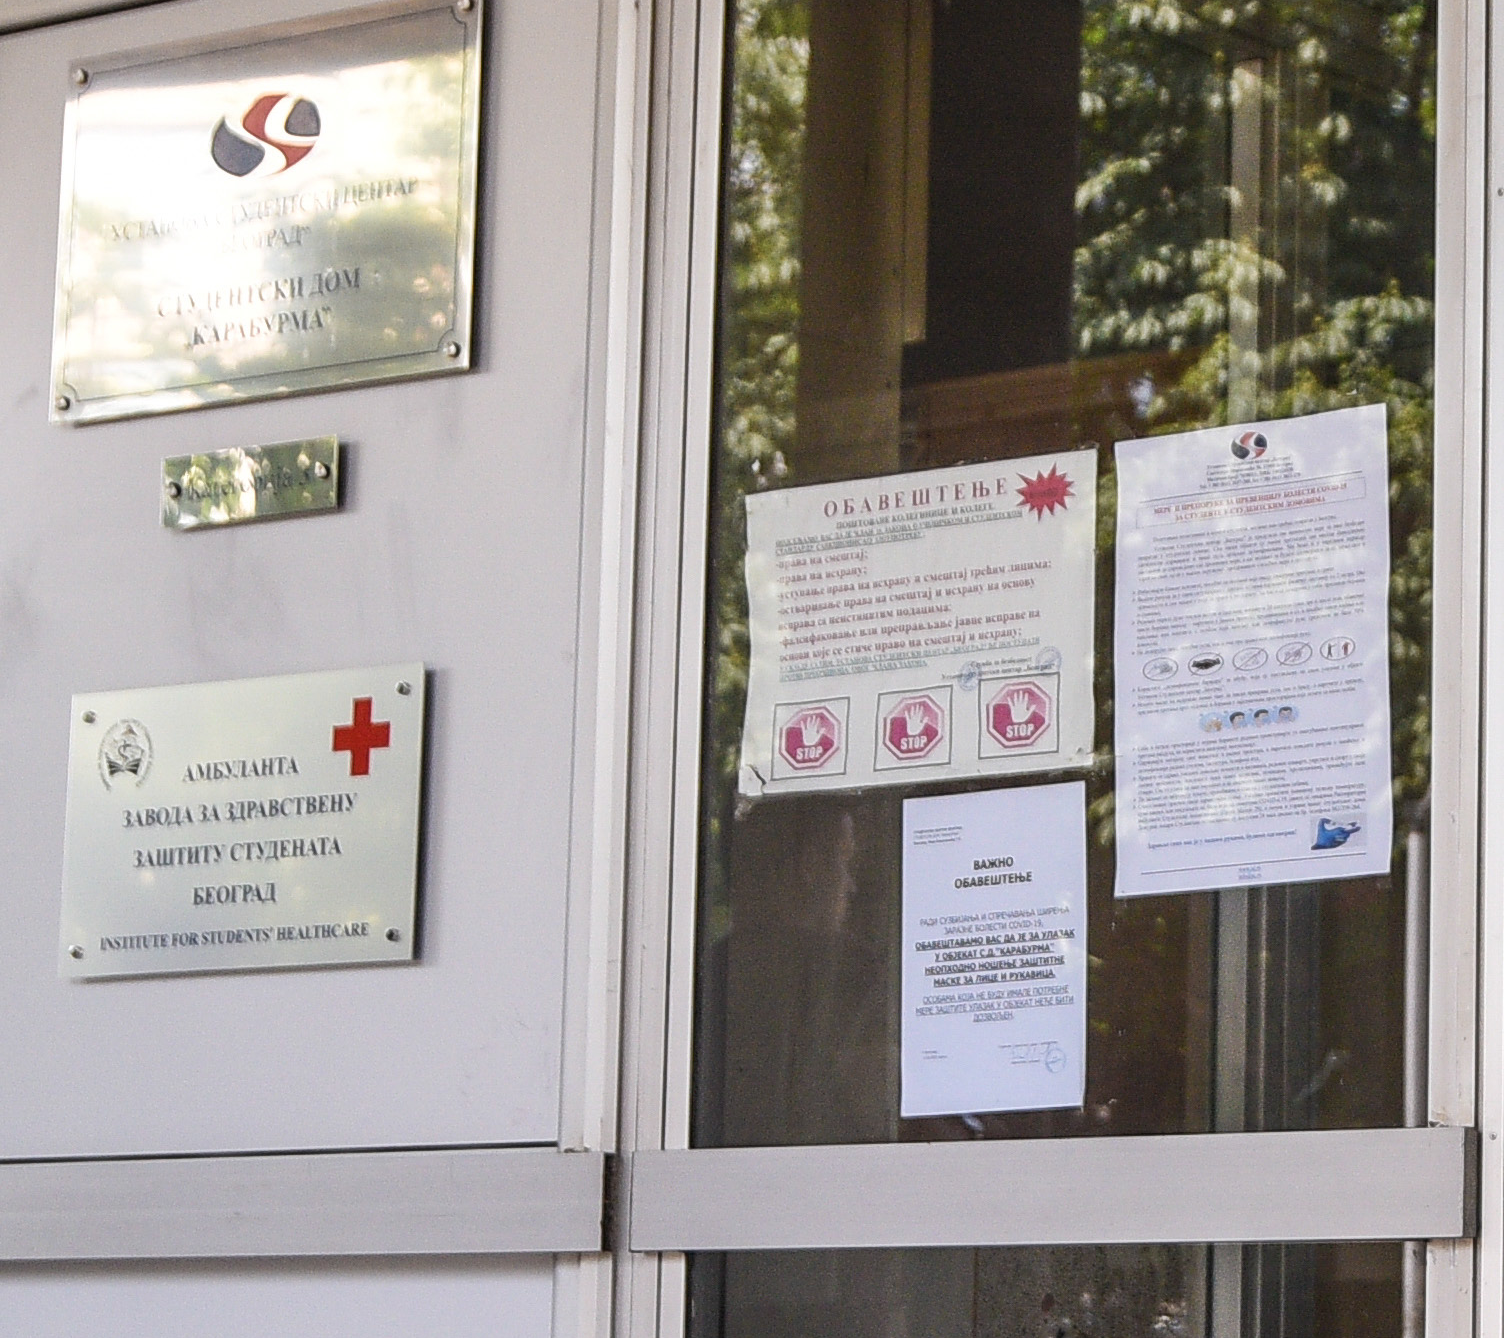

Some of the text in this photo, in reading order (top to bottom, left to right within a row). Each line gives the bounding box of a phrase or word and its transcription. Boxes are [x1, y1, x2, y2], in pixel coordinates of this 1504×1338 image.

[309, 268, 360, 297] ДОМ
[1006, 723, 1034, 738] STOP
[796, 746, 823, 760] STOP
[900, 736, 927, 750] STOP
[182, 756, 299, 782] АМБУЛАНТА
[123, 792, 358, 828] ЗАВОДА ЗА ЗДРАВСТВЕНУ
[133, 836, 342, 868] ЗАШТИТУ СТУДЕНАТА
[973, 856, 1013, 870] ВАЖНО
[954, 871, 1032, 889] ОБАВЕШТЕЊЕ
[193, 882, 276, 906] БЕОГРАД
[100, 934, 168, 951] INSTITUTE
[171, 931, 198, 947] FOR
[276, 922, 369, 941] HEALTHCARE
